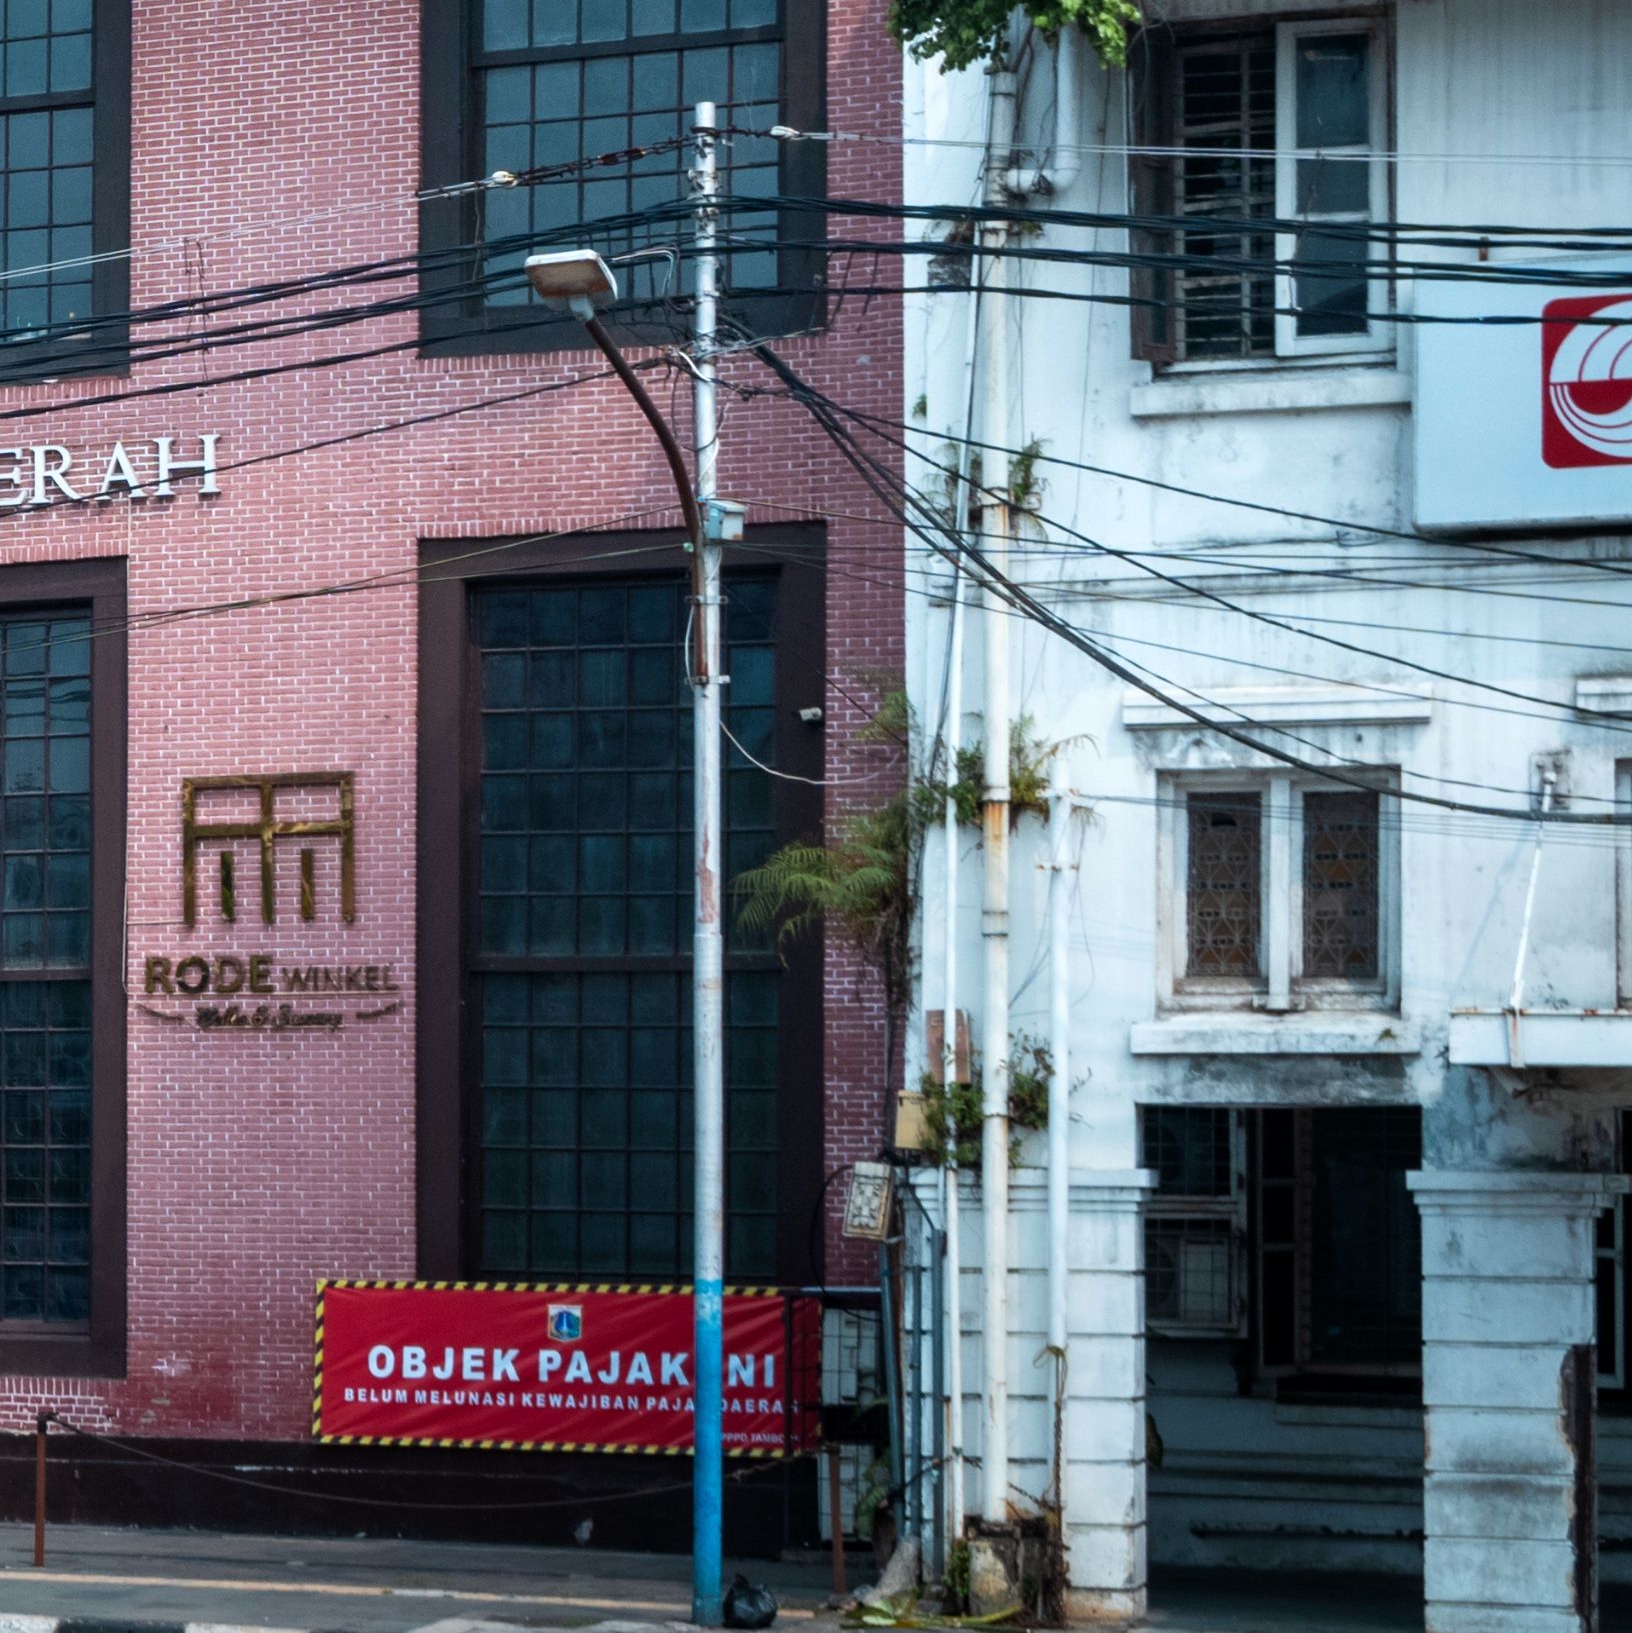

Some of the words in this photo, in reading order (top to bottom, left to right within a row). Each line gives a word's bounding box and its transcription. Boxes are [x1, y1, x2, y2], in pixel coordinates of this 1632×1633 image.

[144, 954, 276, 994] RODE
[282, 964, 400, 992] WINKEL
[368, 1344, 520, 1382] OBJEK
[538, 1349, 690, 1386] PAJAK
[728, 1354, 775, 1388] NI
[344, 1387, 408, 1403] BELUM
[414, 1389, 515, 1407] MELUNASI
[521, 1392, 640, 1410] KEWAJIBAN
[646, 1396, 695, 1412] PAJA
[752, 1433, 800, 1445] TAMBO
